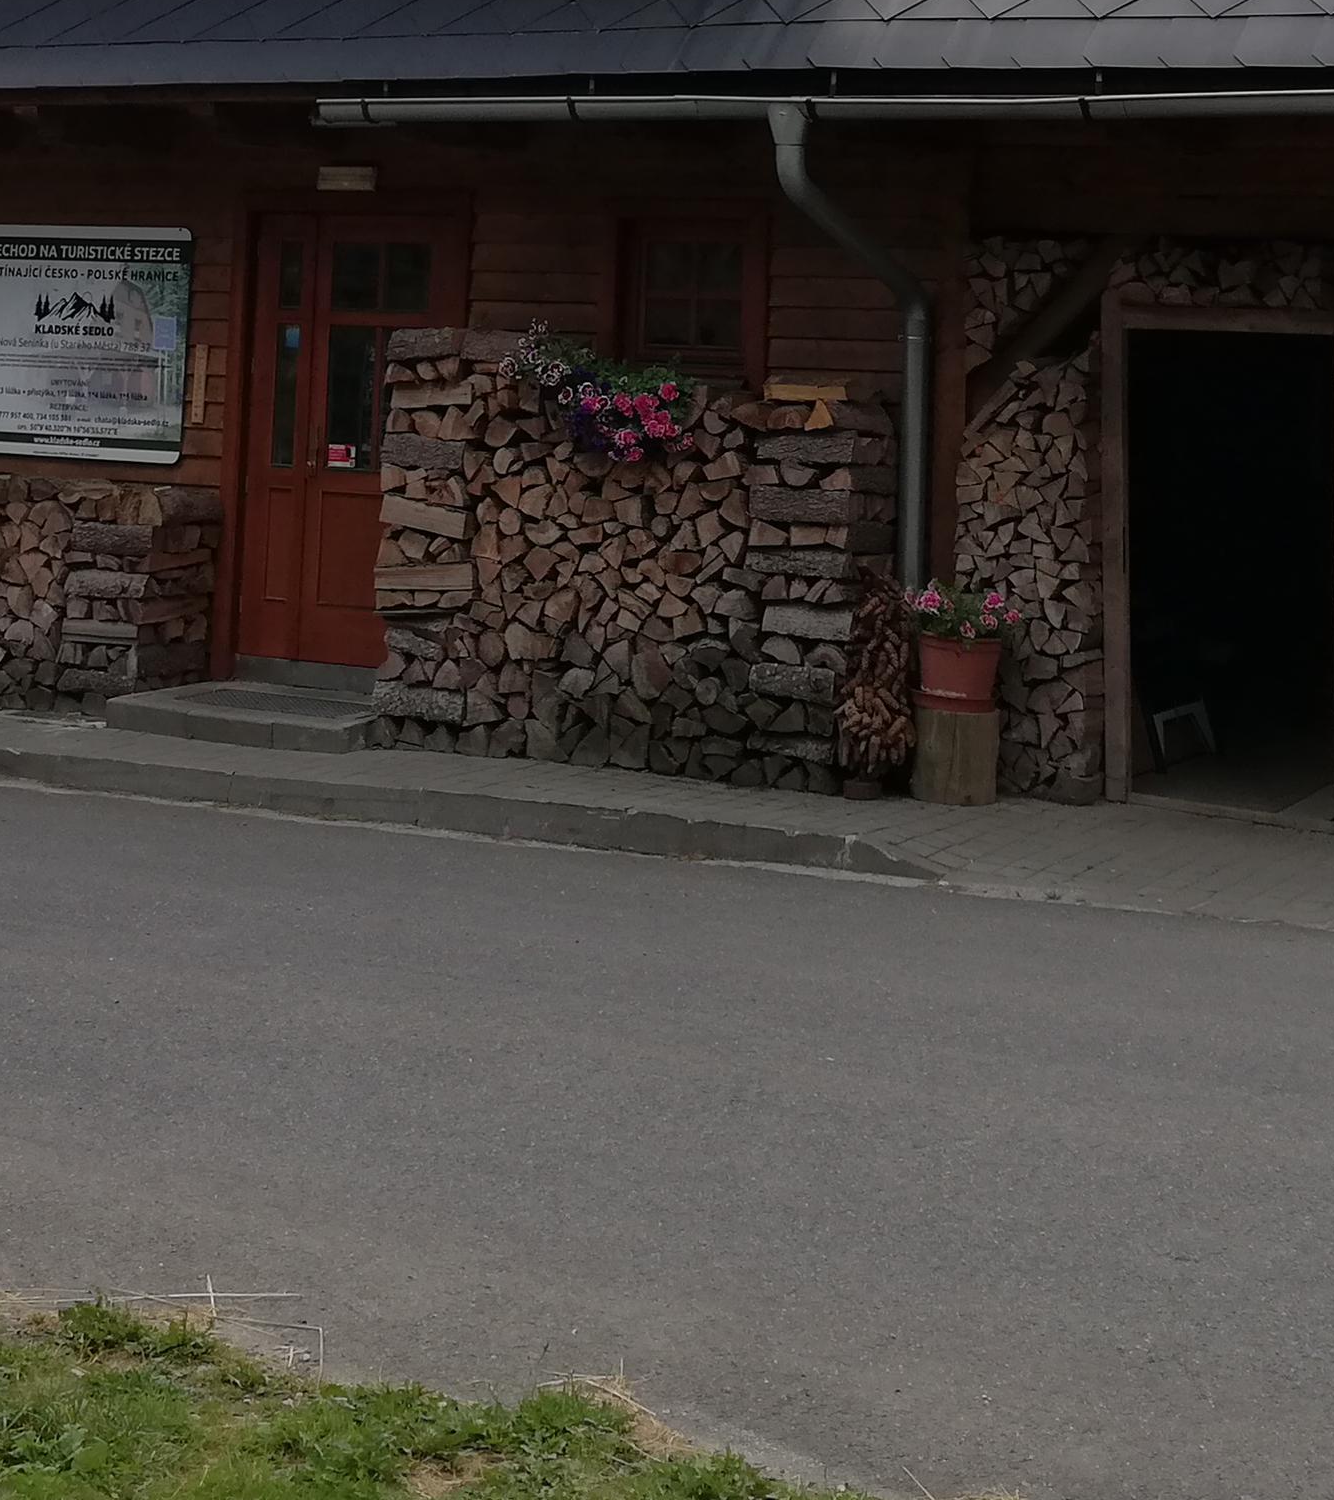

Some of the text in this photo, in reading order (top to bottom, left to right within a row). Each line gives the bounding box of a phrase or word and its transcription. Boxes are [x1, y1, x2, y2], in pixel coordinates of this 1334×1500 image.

[40, 244, 57, 258] NA
[60, 243, 131, 260] TURISTICKÉ
[134, 247, 180, 261] STEZCE
[44, 265, 78, 279] ČESKO
[86, 267, 128, 281] POLSKÉ
[130, 270, 179, 282] HRANICE
[34, 323, 114, 337] KLADSKÉ SEDLO
